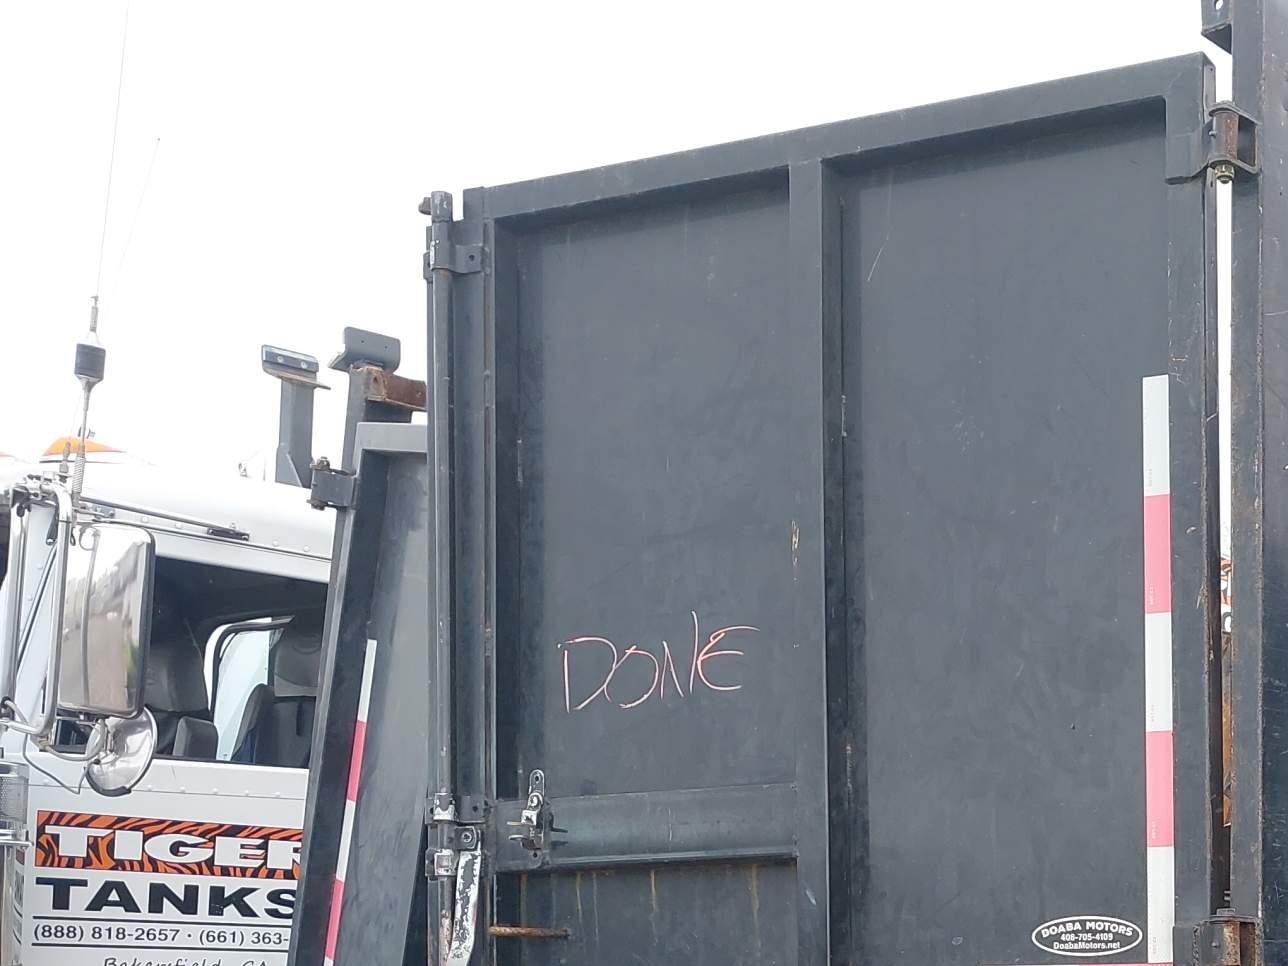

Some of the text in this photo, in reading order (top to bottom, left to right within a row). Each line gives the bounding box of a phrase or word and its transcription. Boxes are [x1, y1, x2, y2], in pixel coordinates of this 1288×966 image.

[558, 611, 760, 713] DONE
[33, 923, 85, 941] (888)
[91, 924, 180, 943] 818-2657
[199, 929, 245, 946] (661)
[1041, 921, 1133, 938] DOABA MOTORS
